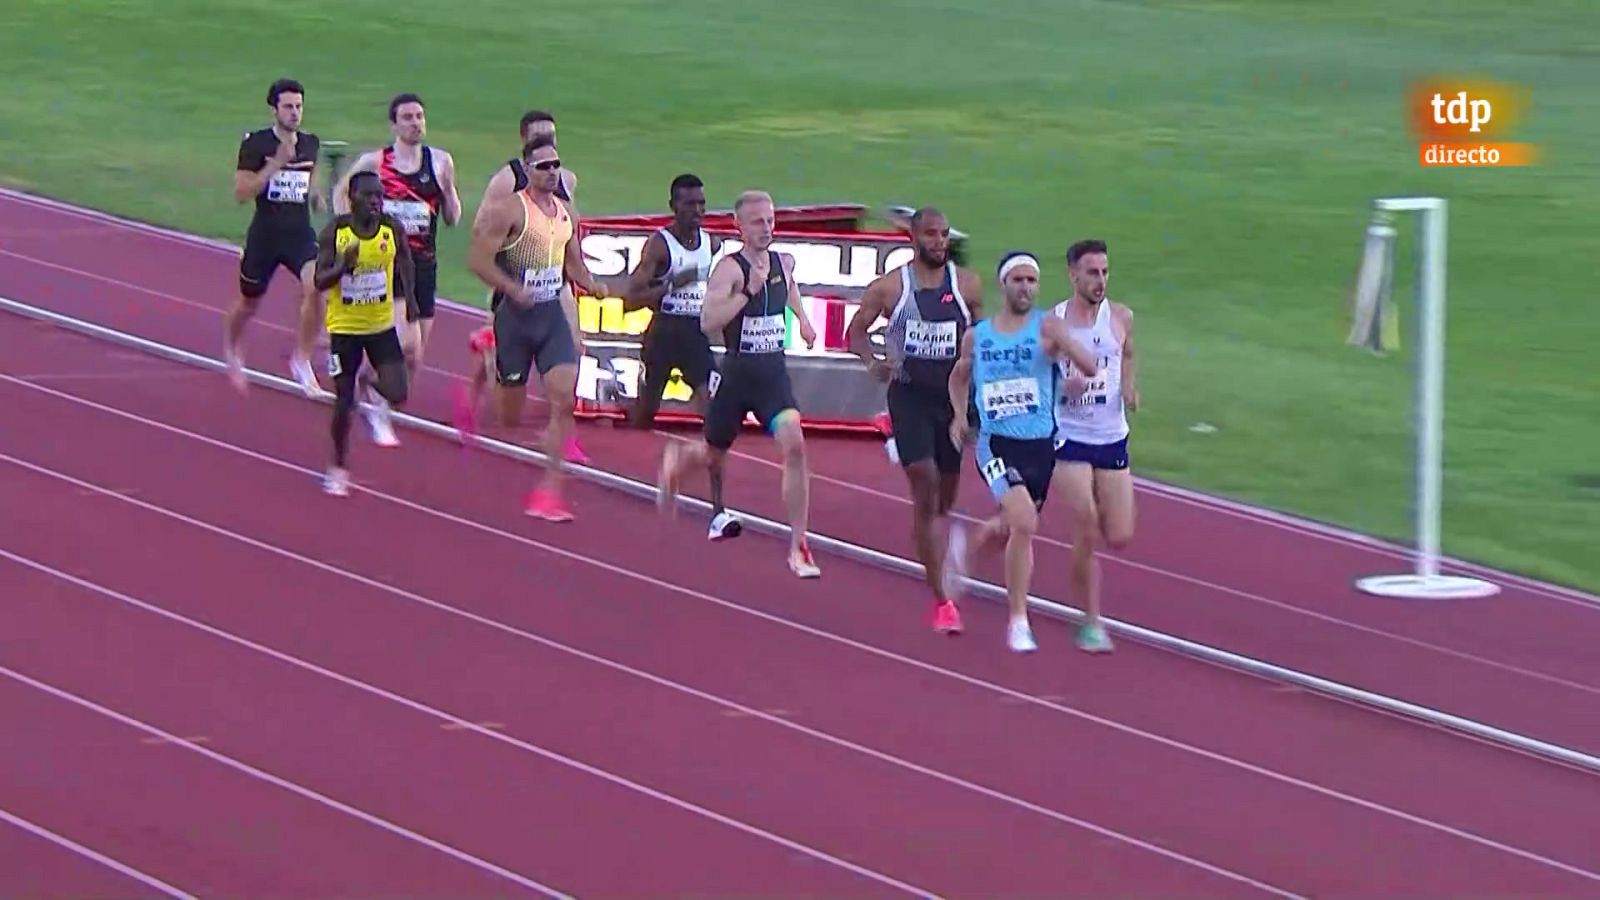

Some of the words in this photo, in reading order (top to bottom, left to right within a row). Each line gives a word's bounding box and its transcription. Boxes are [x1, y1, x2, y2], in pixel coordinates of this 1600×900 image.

[909, 331, 953, 343] CLARKE
[988, 392, 1034, 407] PACER
[987, 459, 1003, 479] 11
